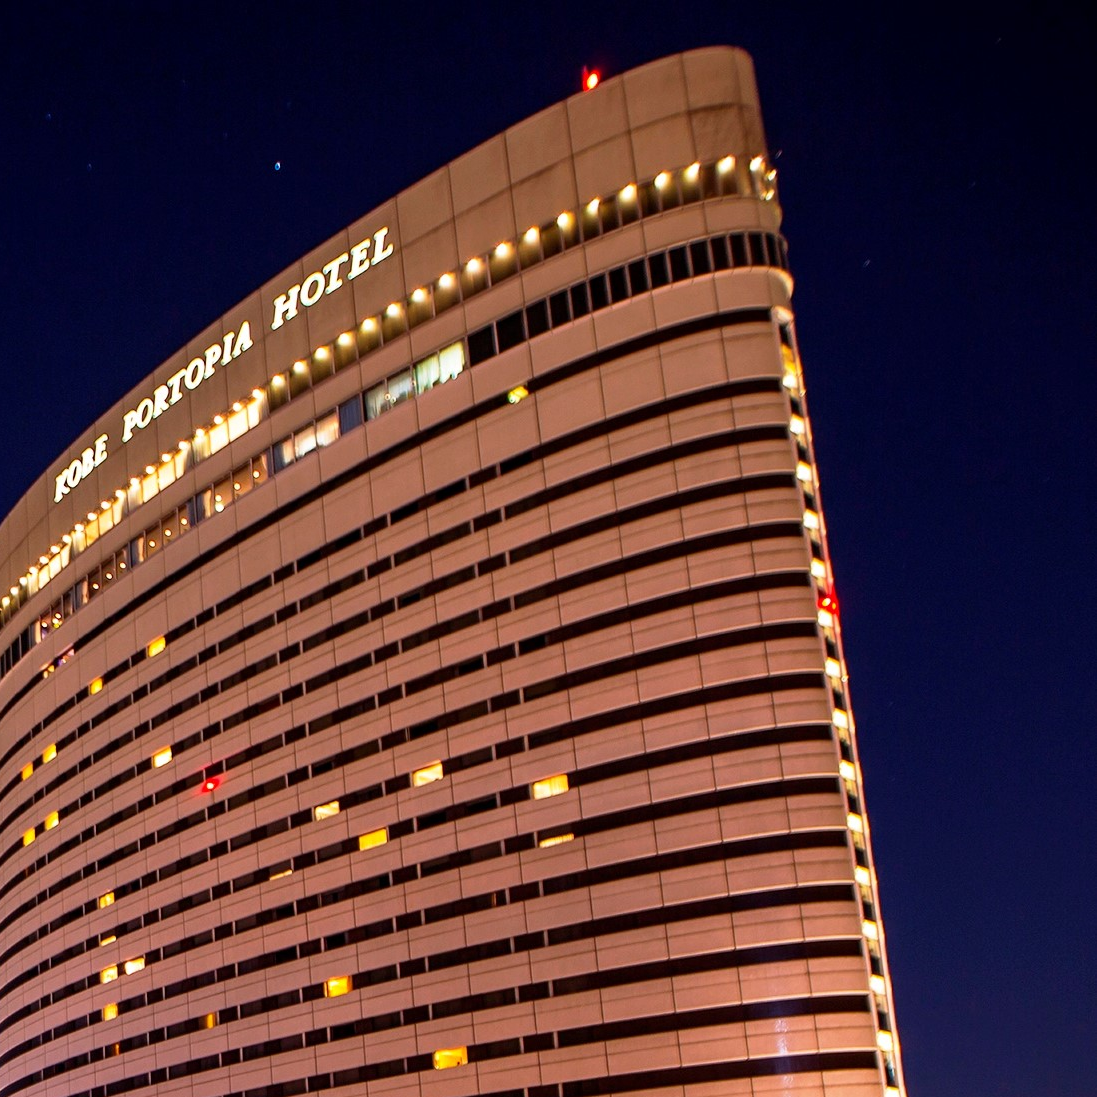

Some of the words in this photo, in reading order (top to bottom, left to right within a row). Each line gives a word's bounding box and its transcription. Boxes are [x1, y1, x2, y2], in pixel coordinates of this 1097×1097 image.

[53, 433, 109, 503] KOBE
[121, 321, 254, 443] PORTOPIA
[270, 226, 394, 330] HOTEL
